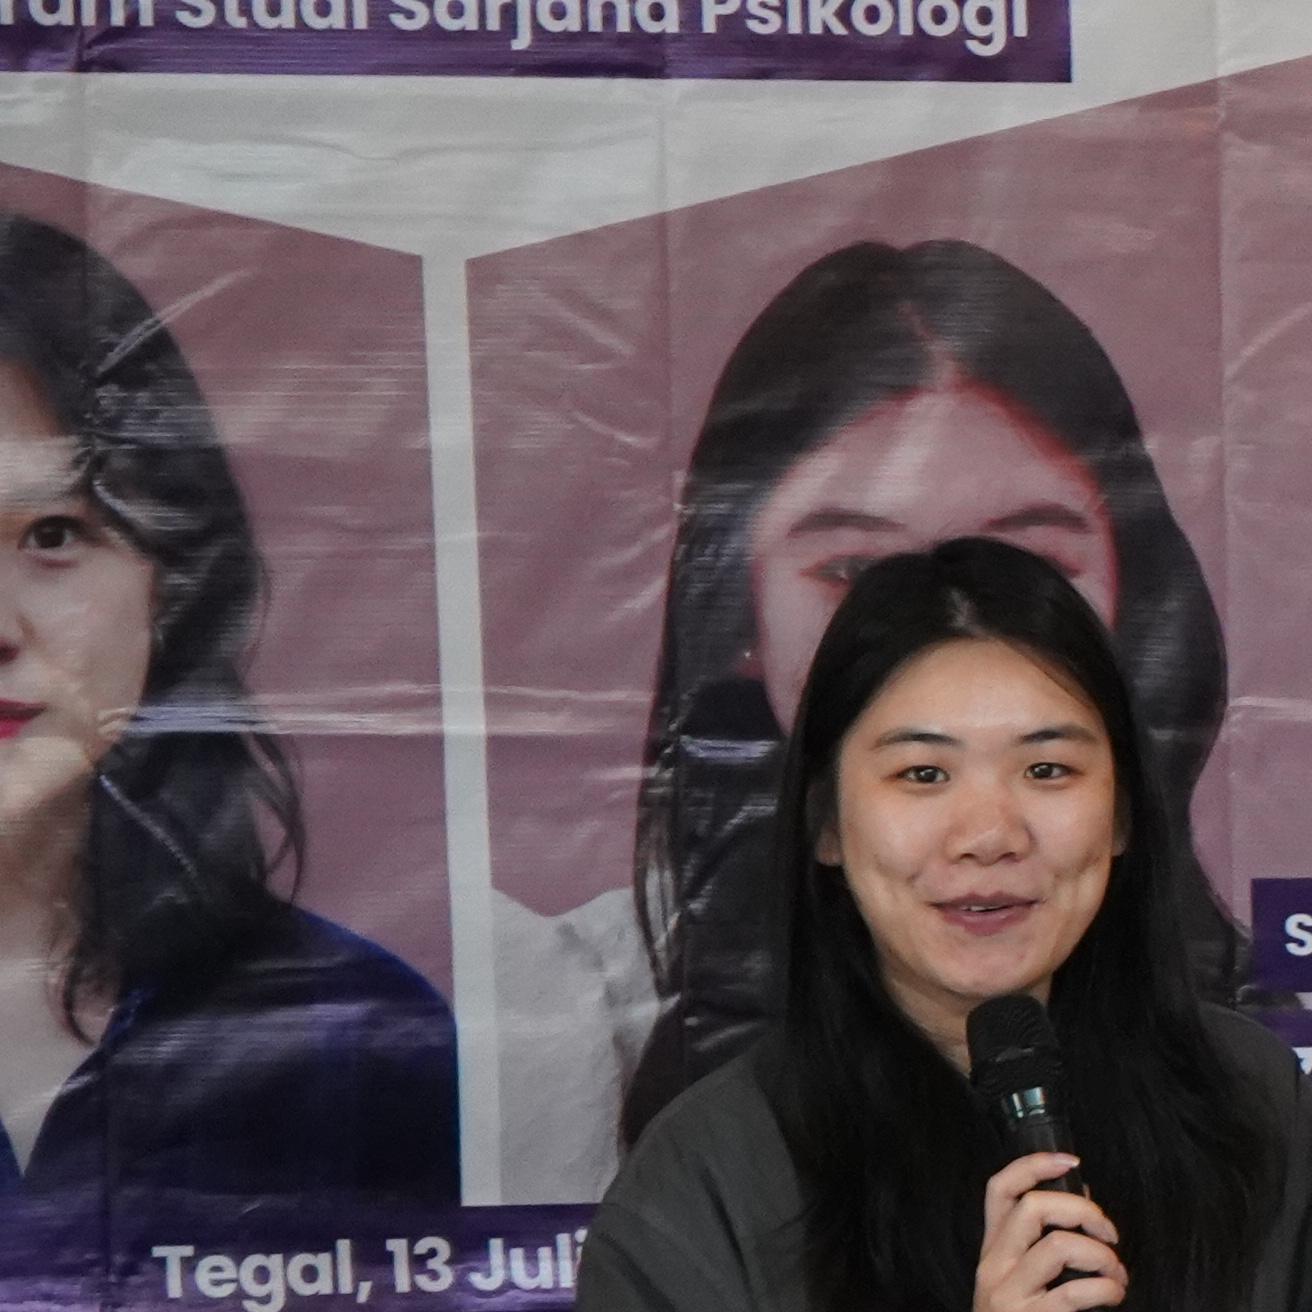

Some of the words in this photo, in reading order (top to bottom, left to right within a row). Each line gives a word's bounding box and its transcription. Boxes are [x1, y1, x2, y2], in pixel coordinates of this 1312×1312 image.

[388, 0, 681, 50] Sarjana
[700, 0, 1029, 57] Psikologi
[386, 1236, 453, 1293] 13
